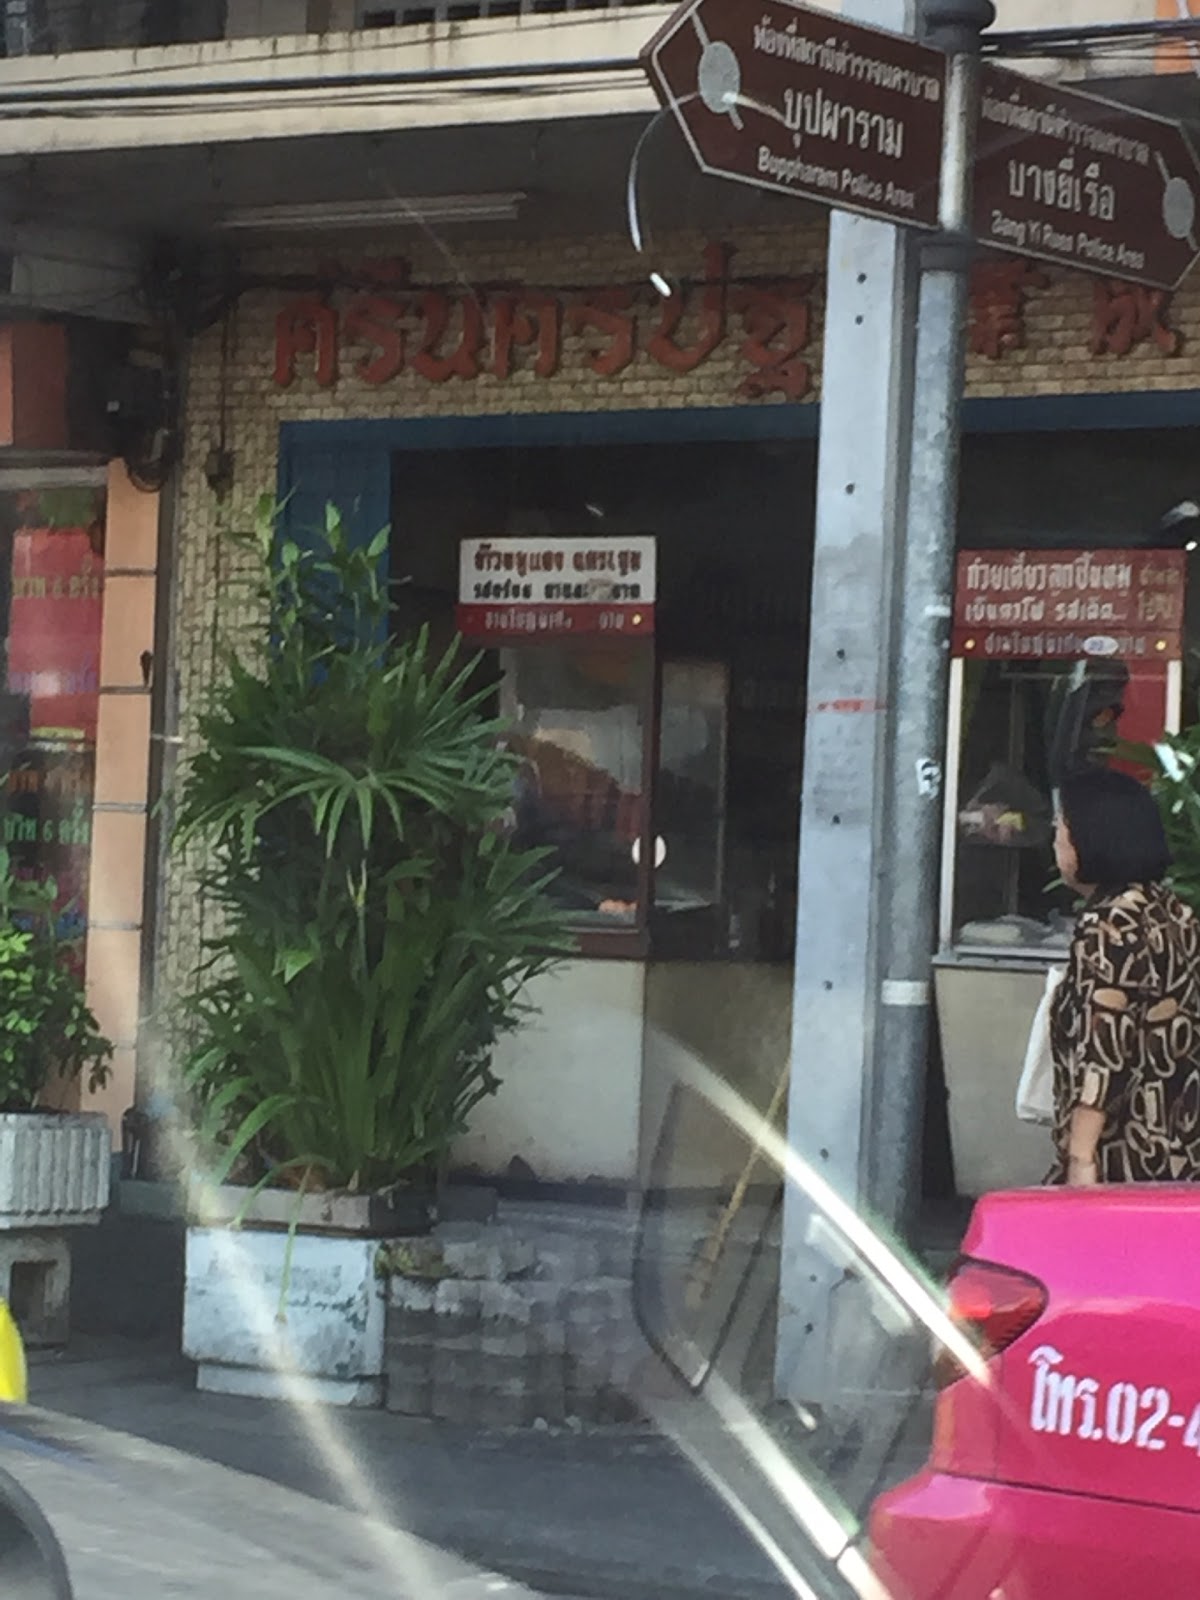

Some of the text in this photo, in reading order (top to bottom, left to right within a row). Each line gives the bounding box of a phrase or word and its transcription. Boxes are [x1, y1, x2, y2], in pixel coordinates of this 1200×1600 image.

[782, 87, 904, 159] บุปผาราม
[757, 145, 915, 209] Buppharam Police Area
[1008, 146, 1116, 221] บางยี่เรือ
[1076, 231, 1114, 262] Police
